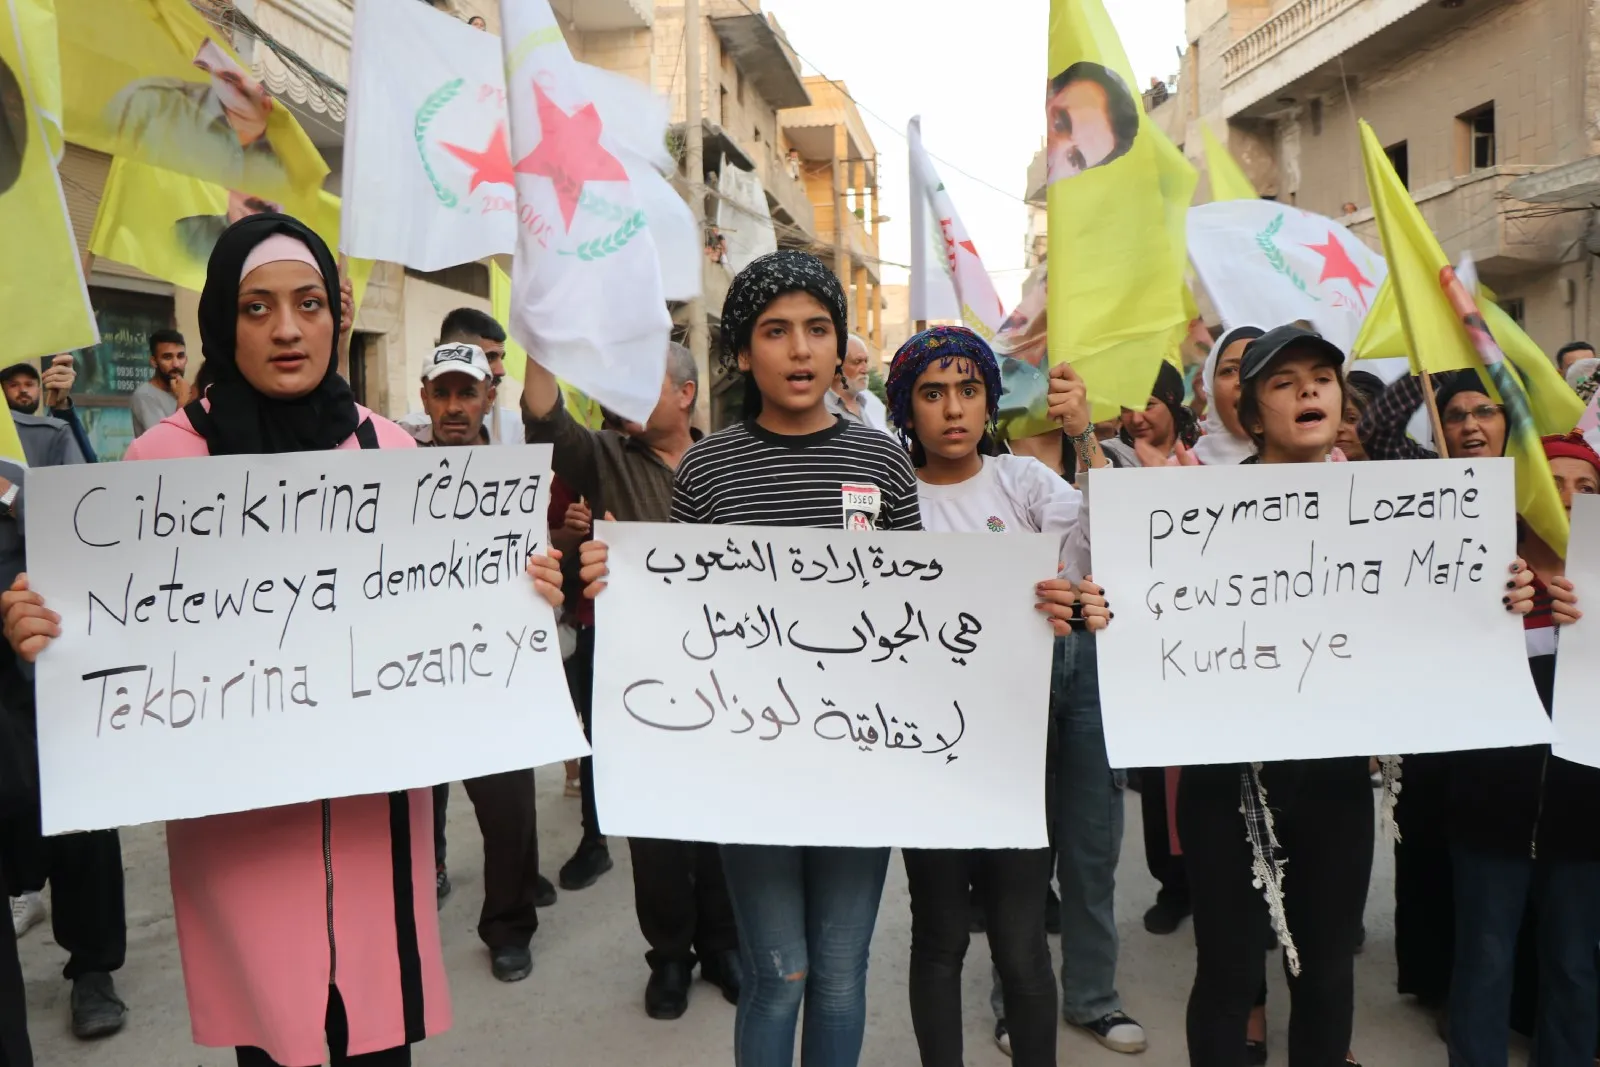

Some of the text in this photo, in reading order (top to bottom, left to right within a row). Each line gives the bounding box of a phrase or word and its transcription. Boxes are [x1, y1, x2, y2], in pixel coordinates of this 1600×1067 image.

[413, 450, 541, 525] rêbaza
[1349, 467, 1479, 525] Lozanê
[88, 547, 337, 650] Neteweya
[646, 537, 943, 589] وحدة إرادة الشعوب
[1404, 536, 1487, 592] Mafê
[682, 601, 982, 671] هي الجواب الأمثل
[81, 652, 318, 737] Têkbirina
[623, 669, 800, 741] لوزان
